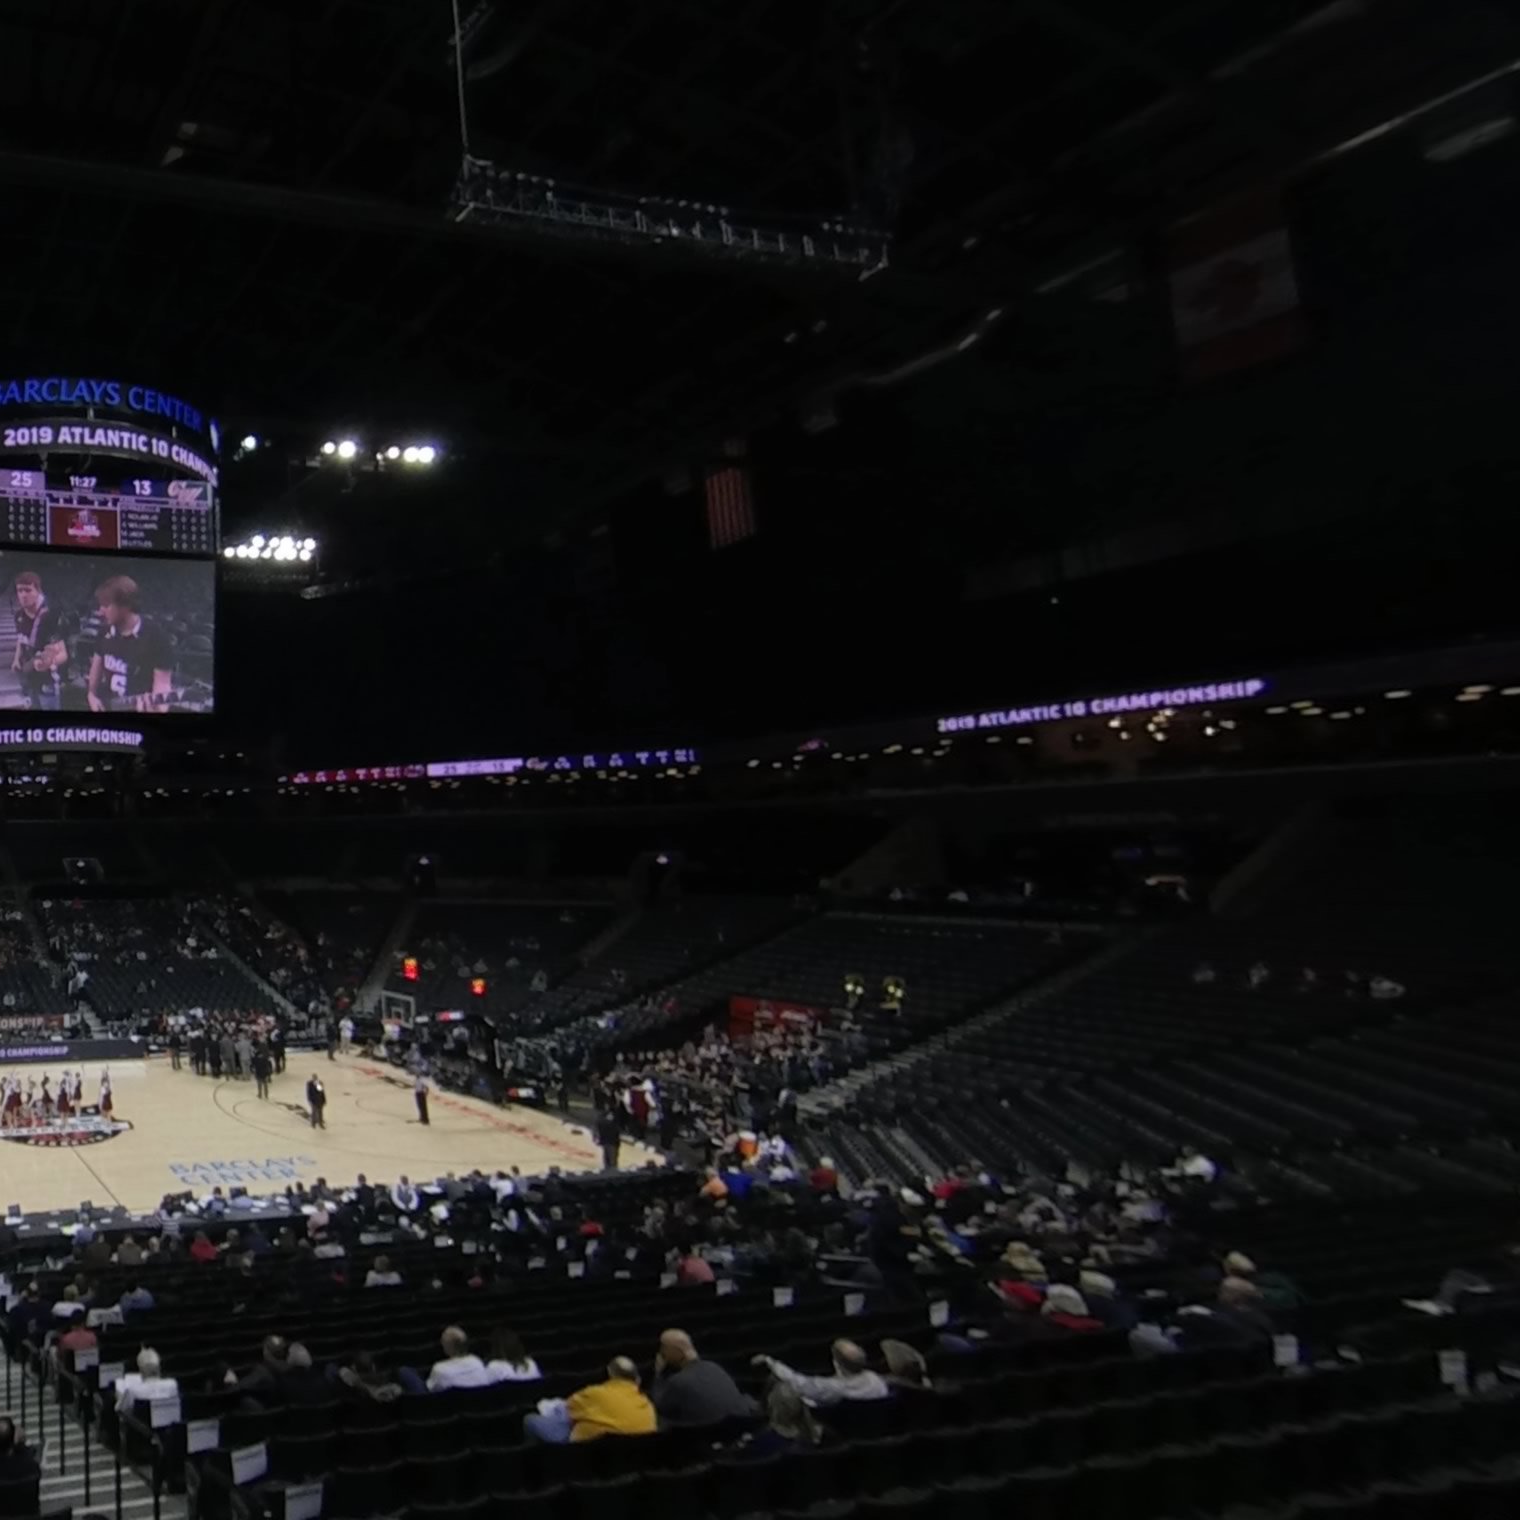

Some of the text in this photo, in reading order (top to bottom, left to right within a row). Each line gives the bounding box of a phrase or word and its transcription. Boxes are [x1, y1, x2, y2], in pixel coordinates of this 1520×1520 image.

[128, 385, 203, 432] CENTER
[3, 426, 53, 447] 2019
[58, 426, 149, 453] ATLANTIC
[151, 437, 169, 458] 10
[10, 471, 33, 487] 25
[69, 475, 97, 488] 11:27
[133, 480, 153, 496] 13
[937, 716, 976, 733] 2019
[978, 705, 1060, 728] ATLANTIC
[1090, 678, 1265, 714] CHAMPIONSHIP
[27, 728, 44, 743] 10
[46, 728, 144, 746] CHAMPIONSHIP
[7, 1045, 69, 1057] CHAMPIONSHIP
[169, 1155, 317, 1176] BARCLAYS
[180, 1168, 305, 1186] CENTER
